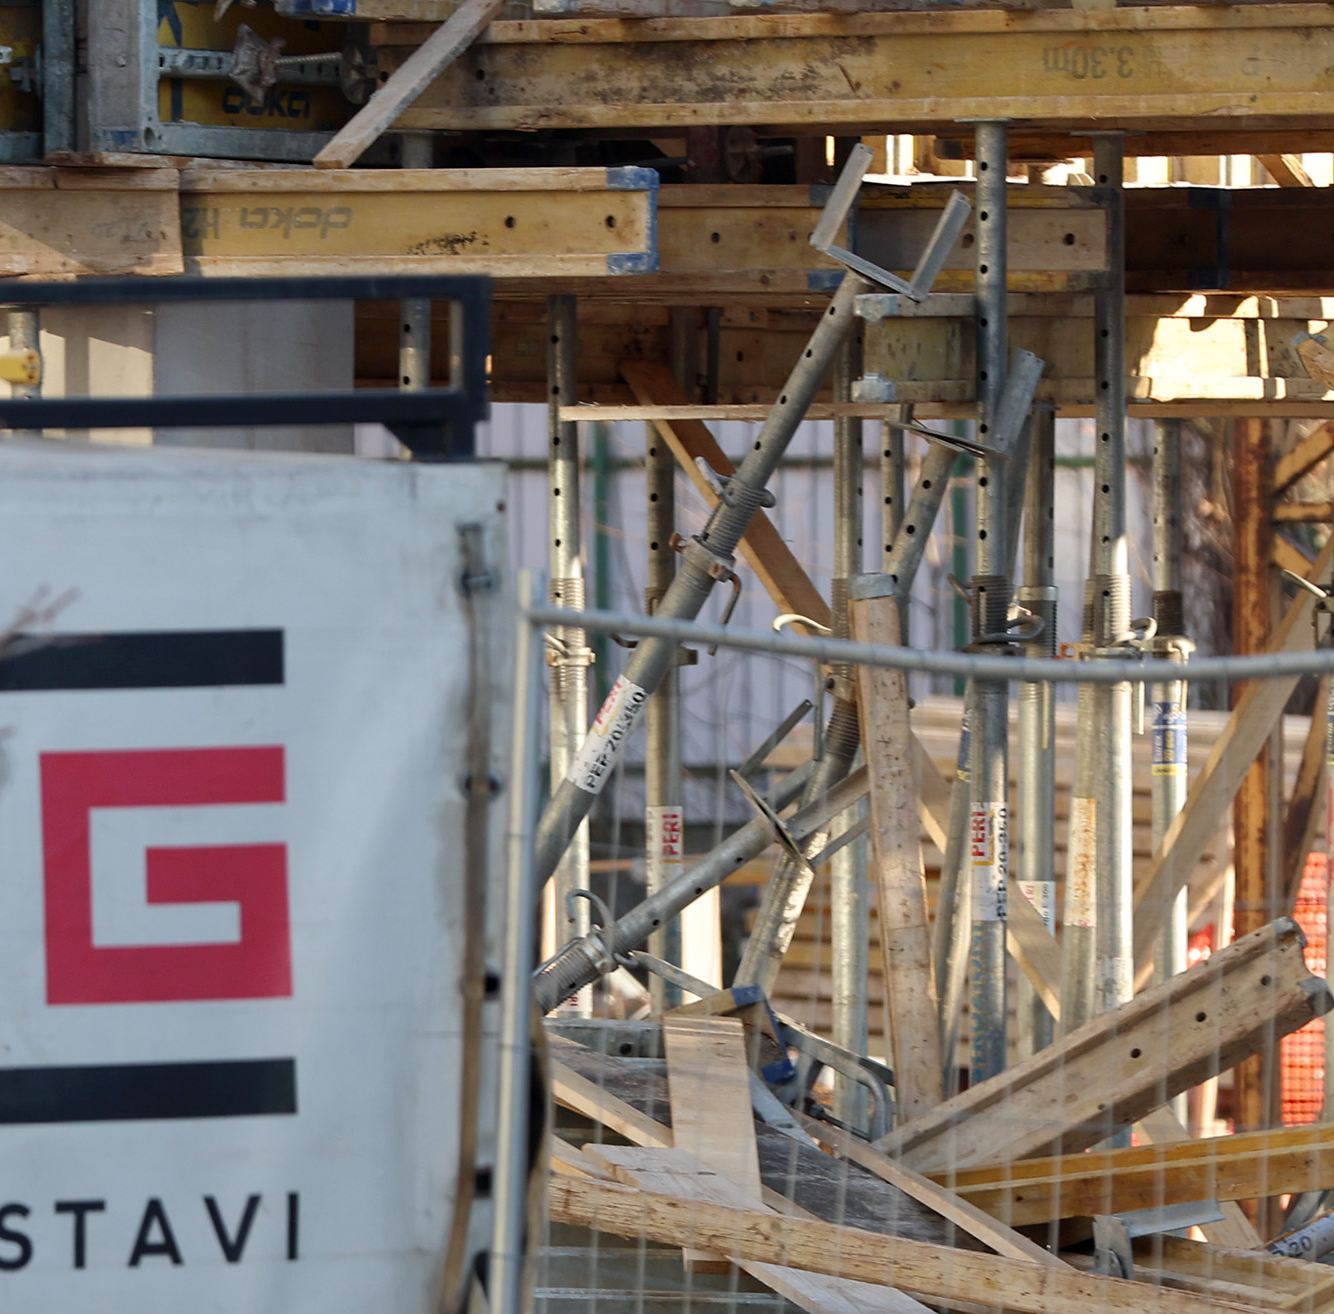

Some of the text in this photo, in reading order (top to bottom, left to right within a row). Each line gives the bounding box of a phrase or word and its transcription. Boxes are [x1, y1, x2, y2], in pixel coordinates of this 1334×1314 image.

[241, 206, 353, 240] doka
[661, 813, 680, 858] PERI
[970, 811, 986, 858] PERI
